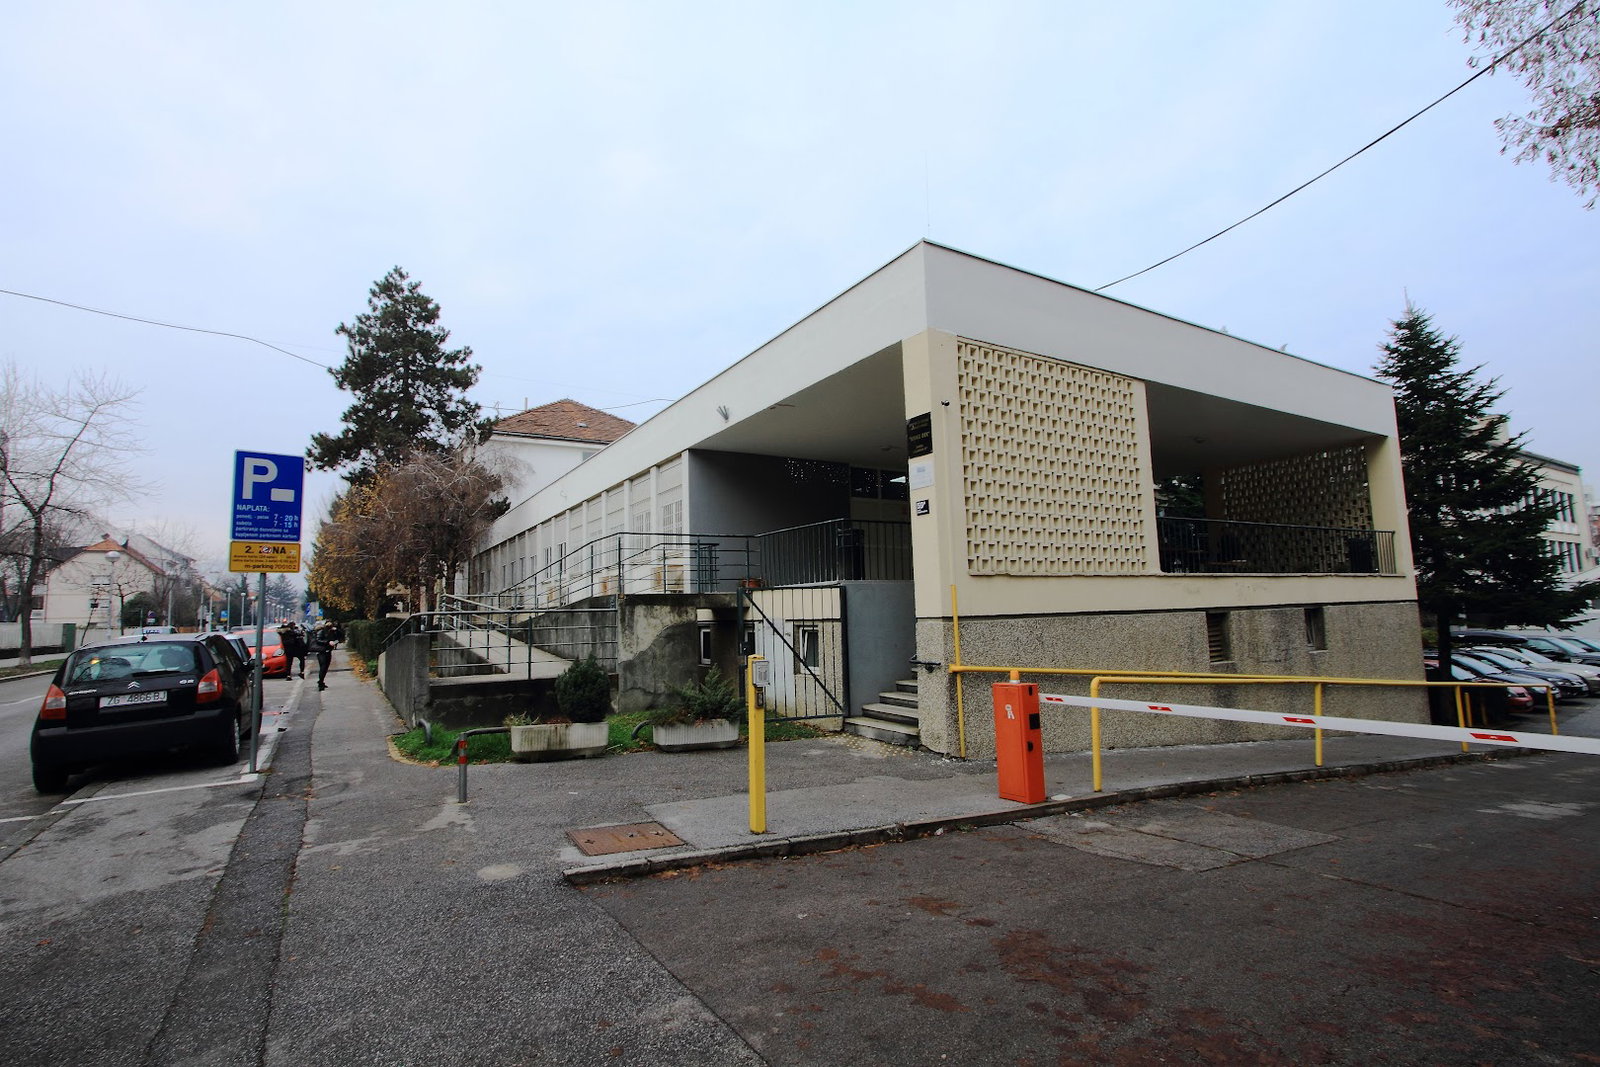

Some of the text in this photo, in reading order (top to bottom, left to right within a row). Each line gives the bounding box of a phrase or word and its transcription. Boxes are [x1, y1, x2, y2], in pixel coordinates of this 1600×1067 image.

[242, 457, 278, 499] P
[236, 504, 270, 512] NAPLATA:
[106, 696, 120, 706] ZG
